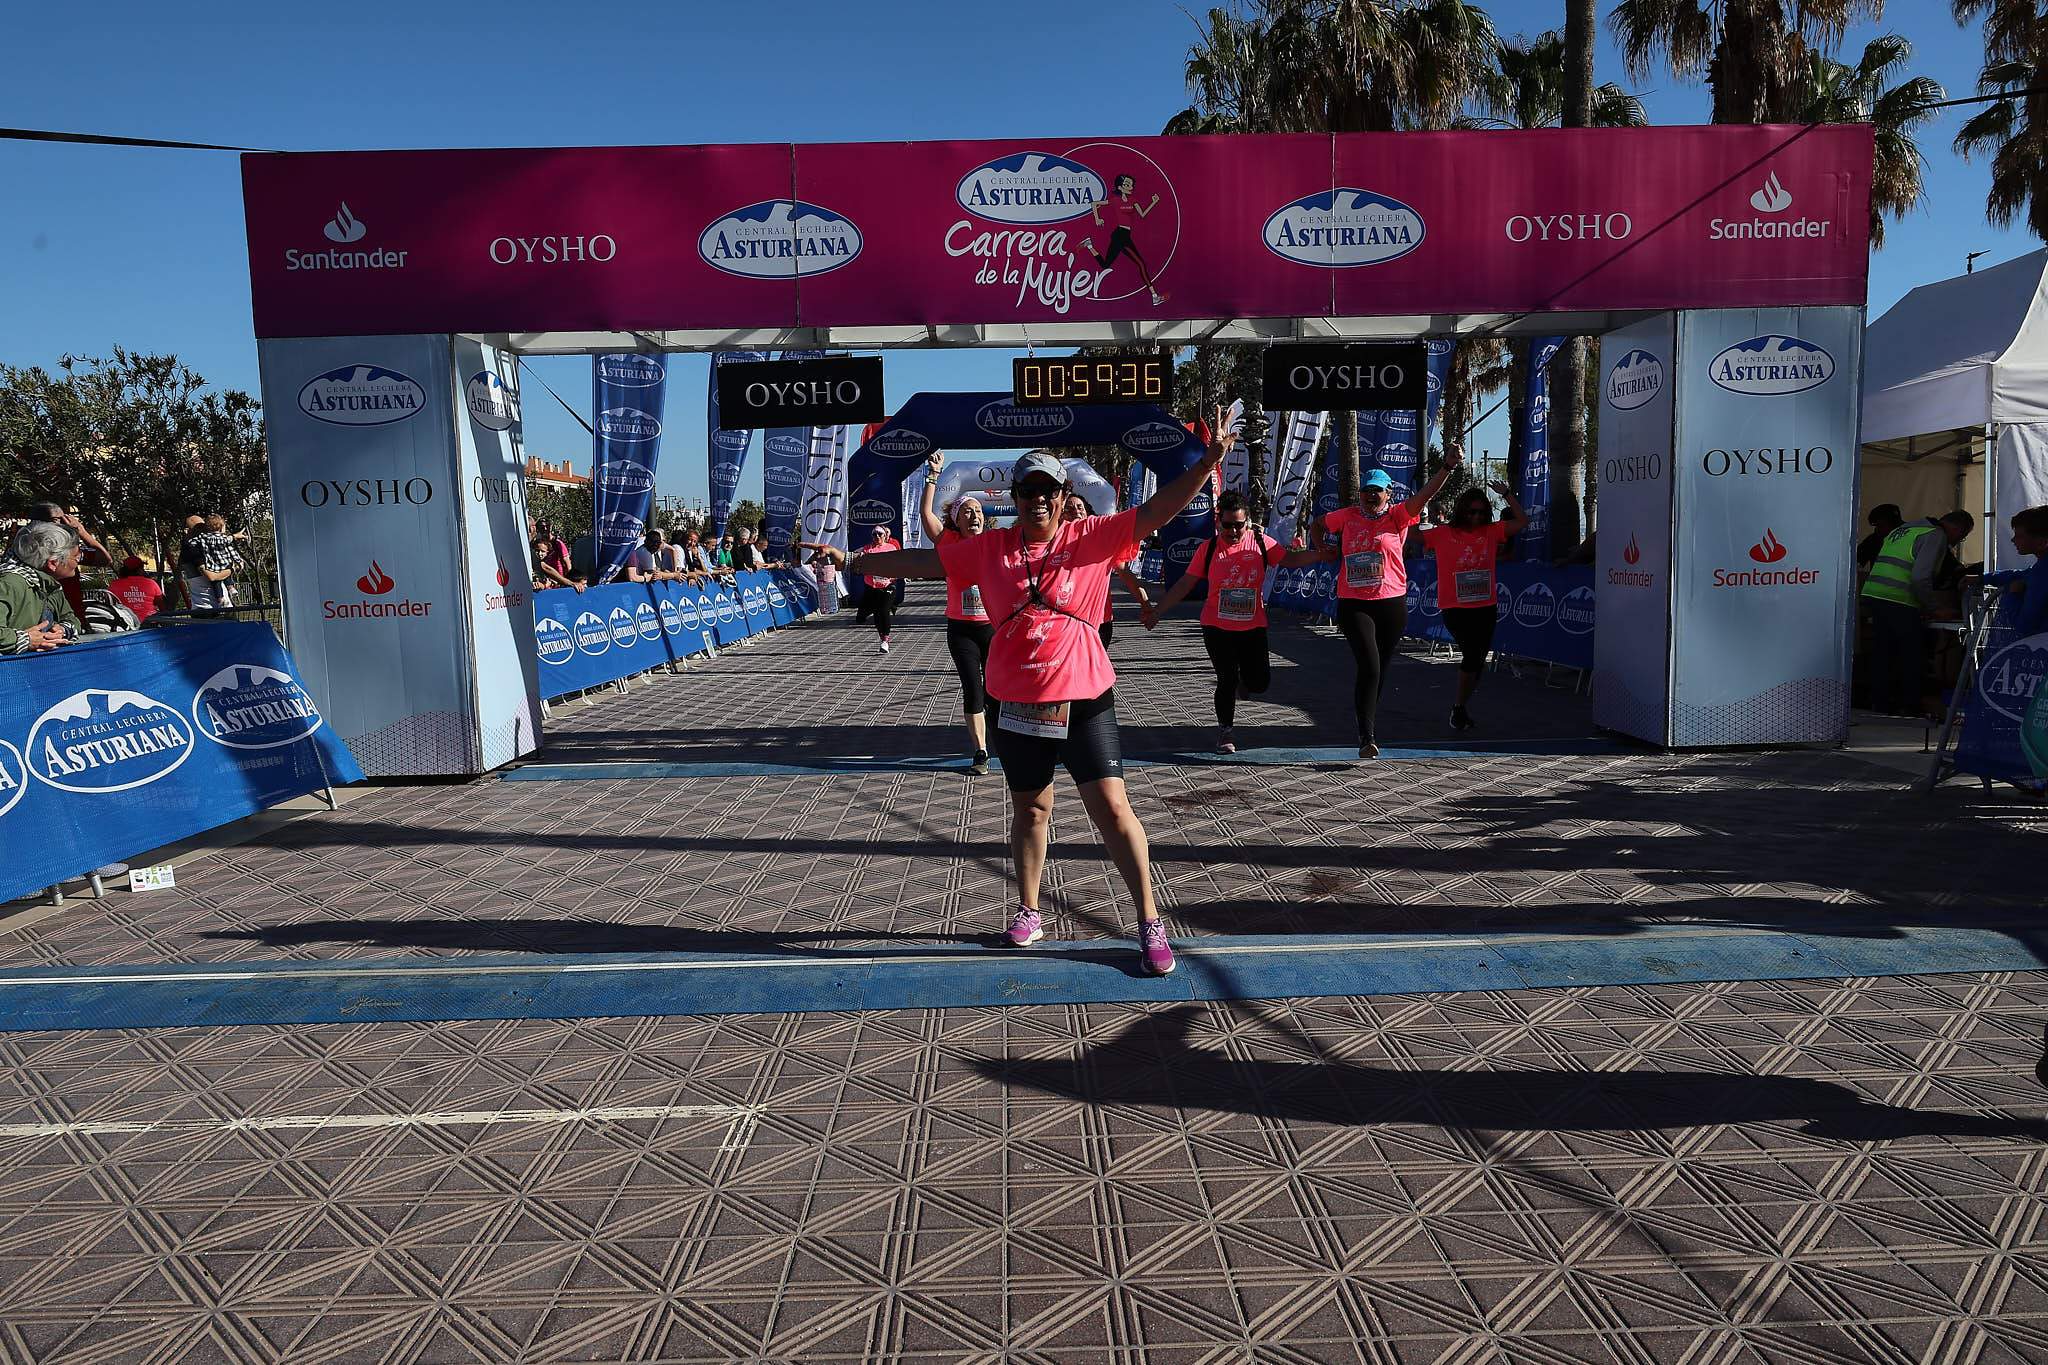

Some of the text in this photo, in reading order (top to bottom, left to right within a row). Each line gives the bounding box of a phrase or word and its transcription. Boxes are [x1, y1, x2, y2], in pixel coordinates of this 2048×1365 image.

[990, 175, 1090, 186] CENTRAL LECHERA
[968, 180, 1094, 207] ASTURIANA
[1300, 214, 1407, 224] CENTRAL LECHERA
[1505, 212, 1633, 242] OYSHO
[1709, 216, 1831, 241] Santander
[736, 227, 787, 236] CENTRAL
[944, 220, 1067, 259] Carrera
[1275, 218, 1412, 247] ASTURIANA
[489, 234, 617, 265] OYSHO
[712, 230, 850, 259] ASTURIANA
[285, 247, 408, 271] Santander
[975, 253, 1113, 314] de la Mujer
[600, 361, 659, 380] ASTURIANA
[1718, 359, 1825, 381] ASTURIANA
[1737, 355, 1778, 363] CENTRAL
[326, 385, 367, 393] CENTRAL
[1024, 363, 1161, 398] 00:59:36
[1290, 364, 1405, 390] OYSHO
[1610, 373, 1659, 400] ASTURIANA
[308, 388, 418, 411] ASTURIANA
[745, 380, 861, 407] OYSHO
[983, 409, 1067, 428] ASTURIANA
[874, 440, 926, 451] ASTURIANA
[1127, 434, 1181, 446] ASTURIANA
[1606, 453, 1661, 483] OYSHO
[1703, 446, 1833, 476] OYSHO
[301, 477, 433, 507] OYSHO
[473, 476, 520, 505] OYSHO
[852, 509, 892, 520] ASTURIANA
[1608, 568, 1654, 588] Santander
[1713, 568, 1820, 587] Santander
[324, 599, 433, 620] Santander
[484, 591, 524, 612] Santander
[536, 637, 573, 656] ASTURIANA
[577, 629, 609, 647] ASTURIANA
[218, 691, 258, 707] CENTRAL
[62, 709, 168, 741] CENTRAL LECHERA
[208, 696, 319, 736] ASTURIANA
[43, 723, 188, 778] ASTURIANA
